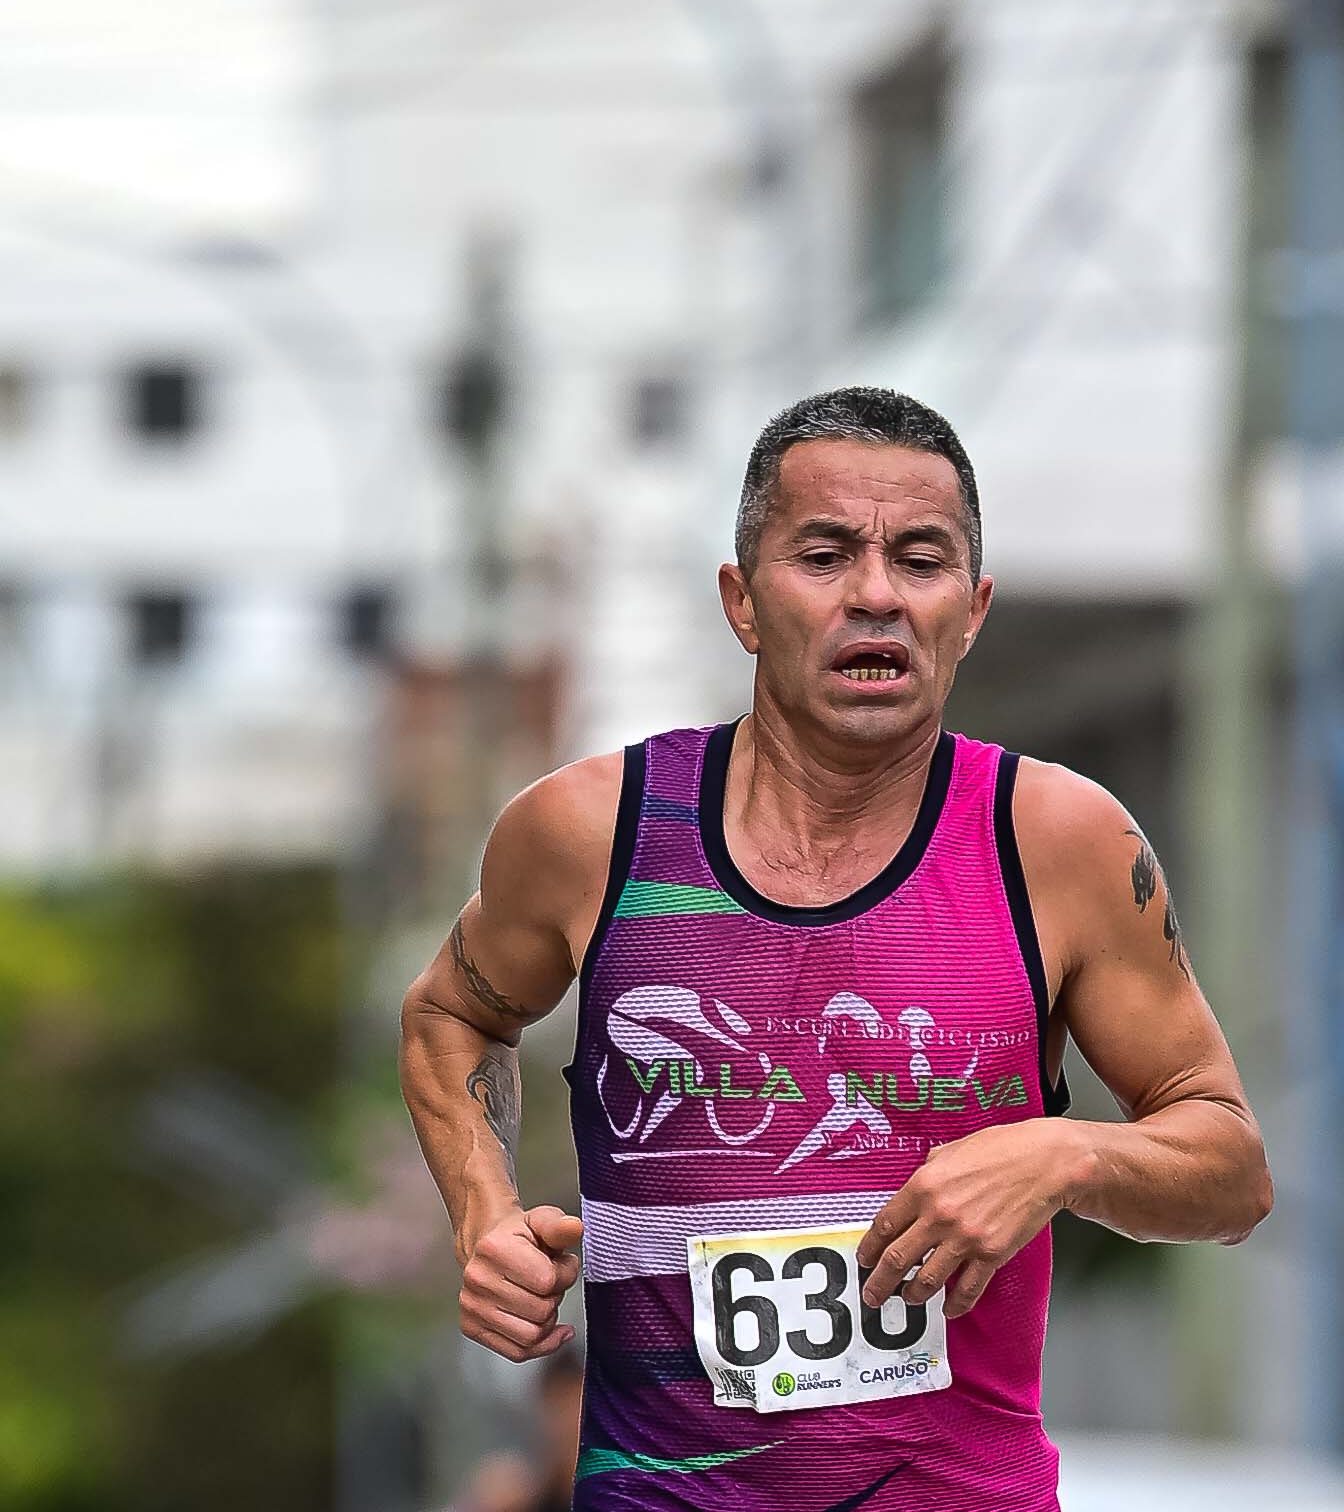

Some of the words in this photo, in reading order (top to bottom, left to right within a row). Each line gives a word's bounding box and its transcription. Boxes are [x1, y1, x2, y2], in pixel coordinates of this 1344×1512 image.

[626, 1058, 807, 1103] VILLA
[845, 1071, 1025, 1112] NUEVA
[797, 1372, 821, 1383] CLUB
[859, 1362, 928, 1384] CARUSO
